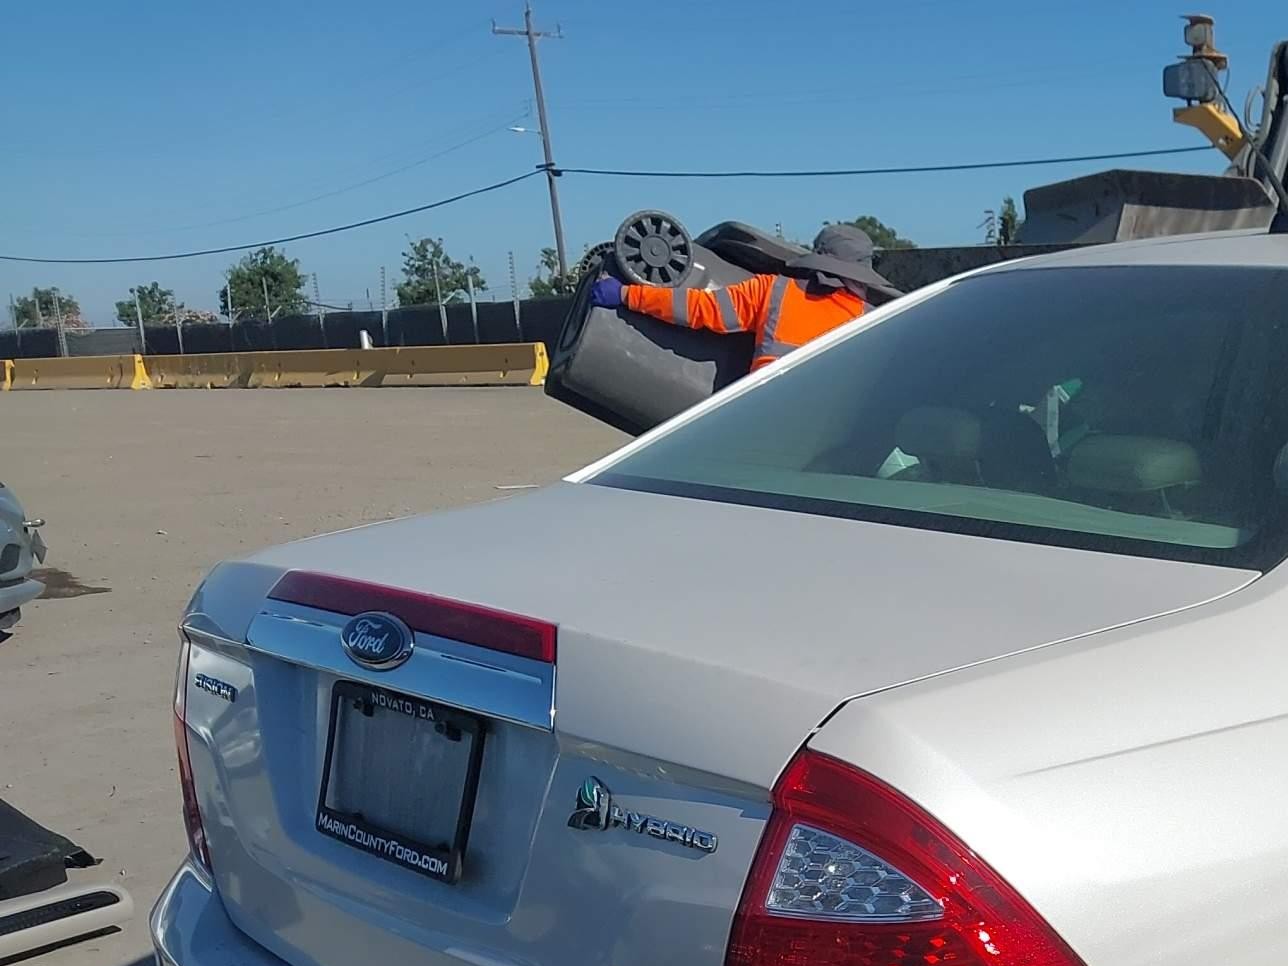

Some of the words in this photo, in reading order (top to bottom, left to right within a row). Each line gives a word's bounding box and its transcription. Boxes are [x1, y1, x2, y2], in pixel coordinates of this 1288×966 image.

[348, 619, 390, 654] Ford
[371, 692, 416, 720] NOVATO,
[419, 705, 434, 721] CA
[611, 805, 719, 854] HYBRID
